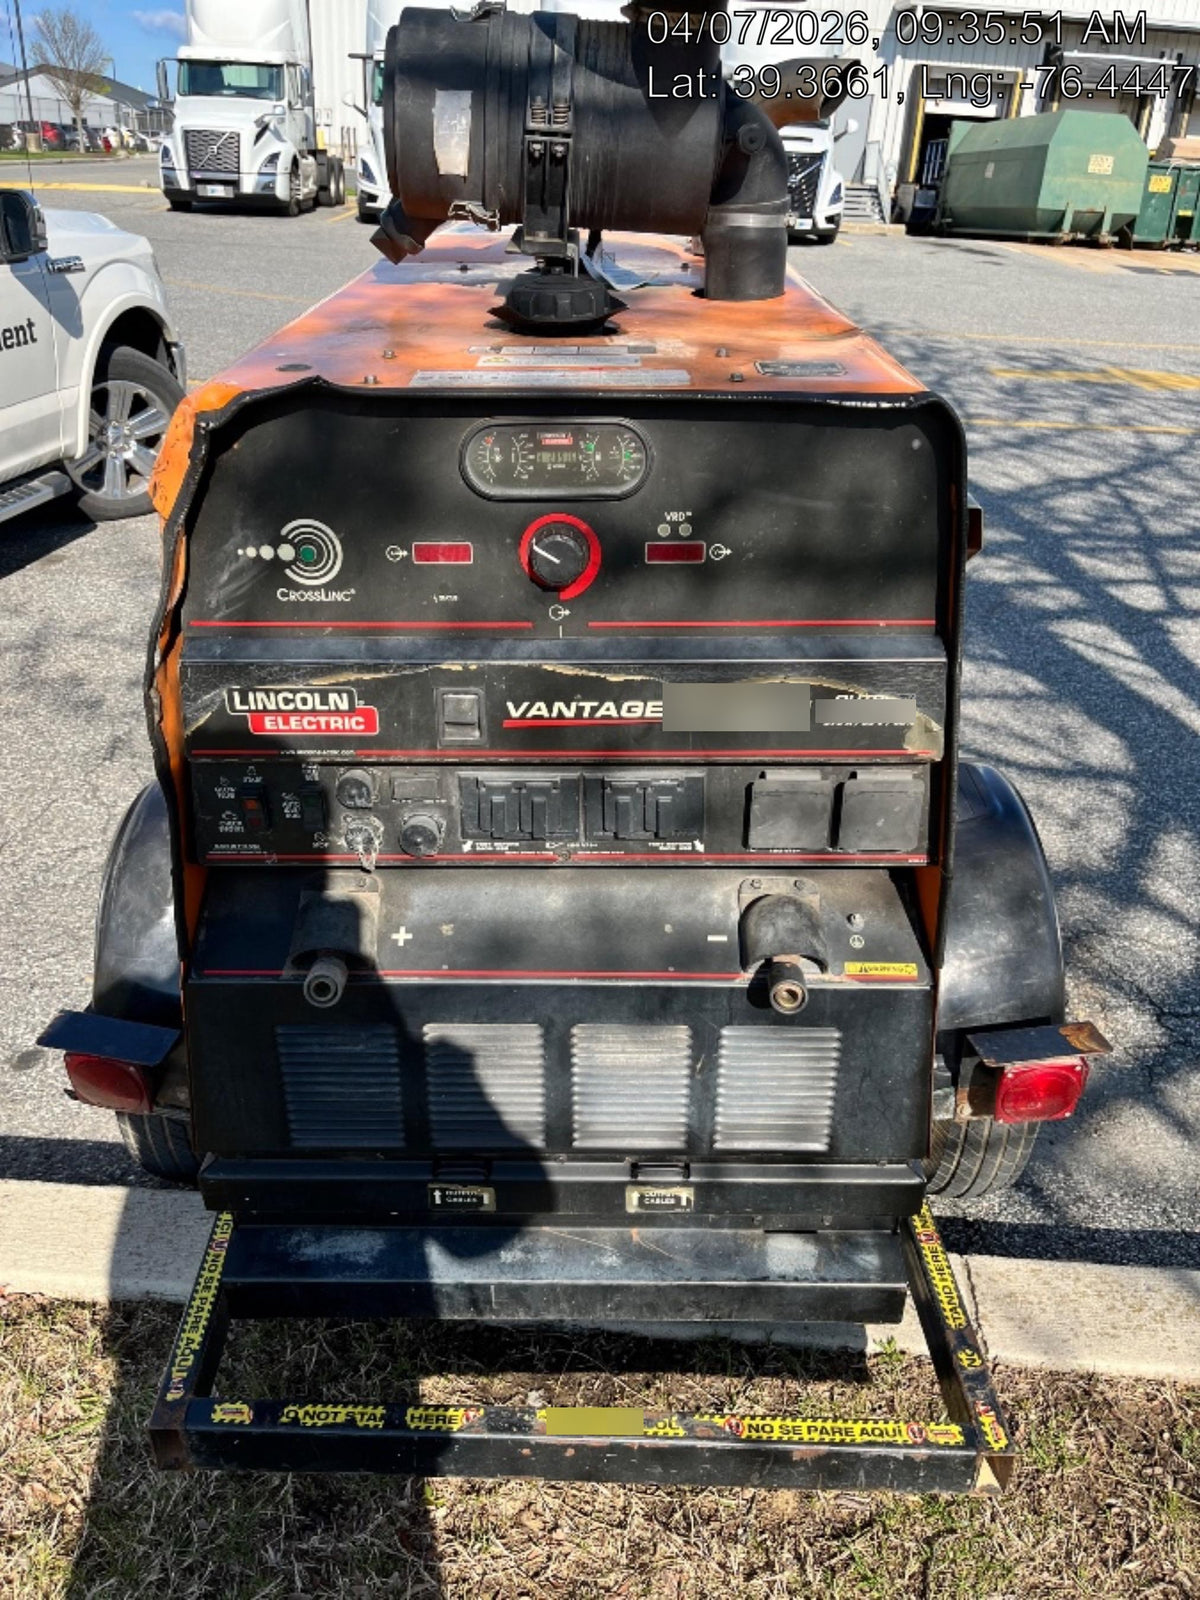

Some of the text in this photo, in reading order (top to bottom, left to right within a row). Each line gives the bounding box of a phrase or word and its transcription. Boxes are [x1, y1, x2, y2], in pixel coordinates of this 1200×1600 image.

[0, 318, 37, 351] ent
[232, 690, 350, 711] LINCOLN
[505, 701, 663, 719] VANTAGE
[263, 715, 366, 731] ELECTRIC
[207, 1252, 222, 1273] NO
[927, 1245, 950, 1283] HERE
[201, 1276, 215, 1294] SE
[188, 1297, 209, 1335] PARE
[941, 1284, 963, 1329] TAND
[303, 1410, 342, 1421] NOT
[410, 1412, 460, 1425] HERE
[747, 1422, 775, 1434] NO
[779, 1424, 802, 1436] SE
[806, 1425, 855, 1438] PARE
